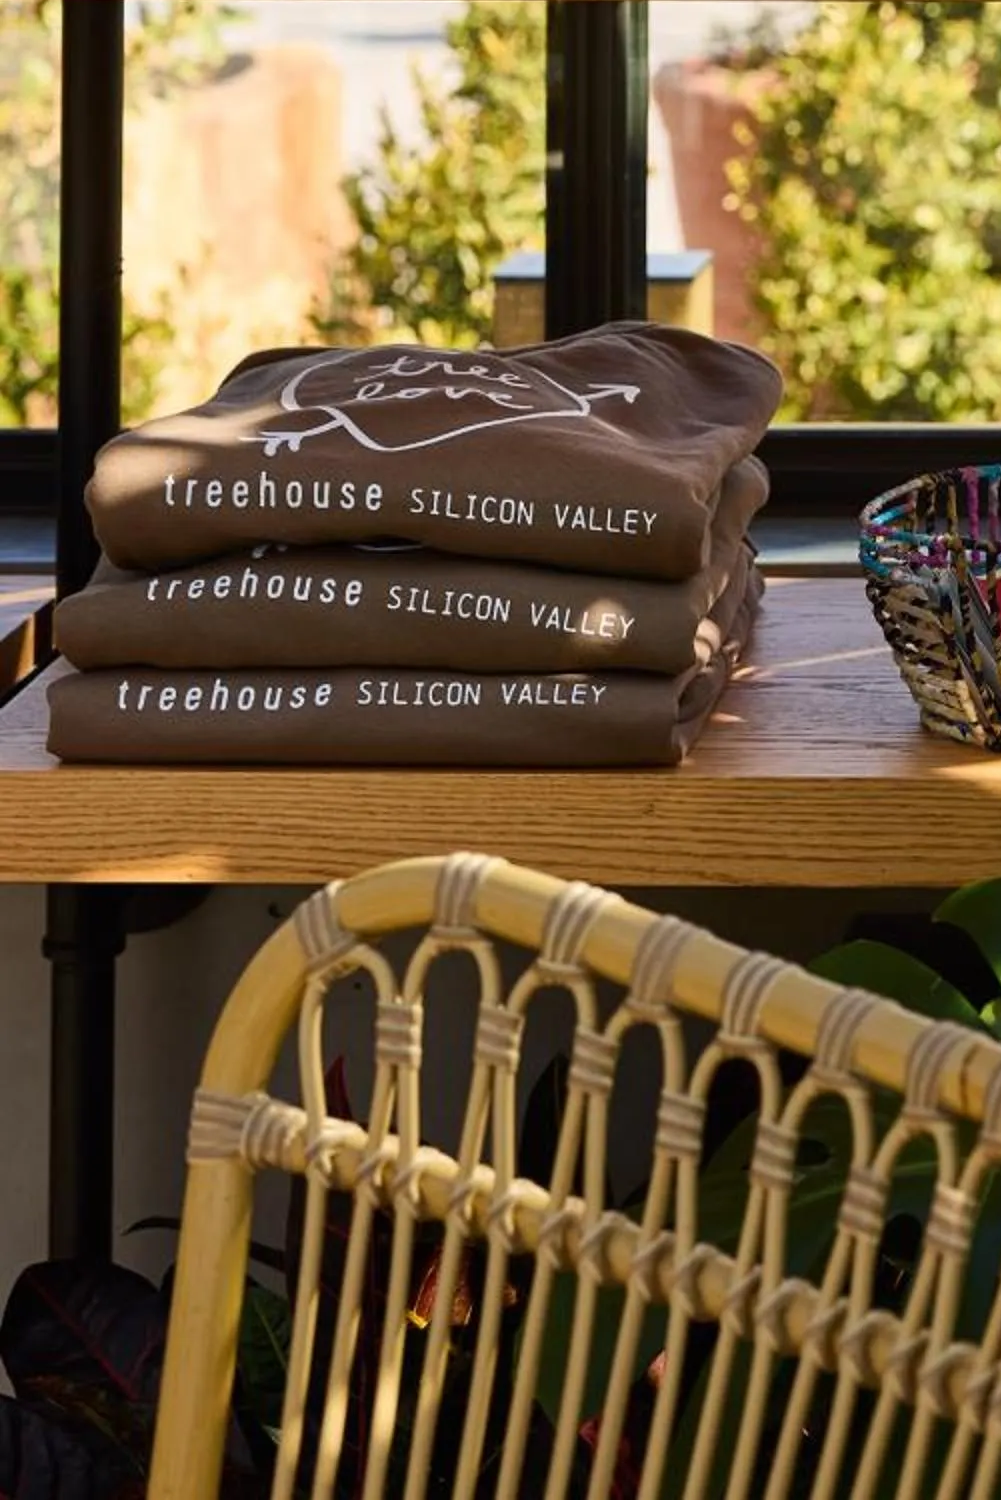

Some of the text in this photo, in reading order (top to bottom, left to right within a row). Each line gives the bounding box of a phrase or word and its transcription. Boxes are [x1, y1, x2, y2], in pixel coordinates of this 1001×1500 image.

[353, 355, 532, 388] tree
[355, 382, 534, 410] love
[164, 471, 658, 535] treehouse SILICON VALLEY
[146, 567, 635, 640] treehouse SILICON VALLEY
[118, 678, 607, 711] treehouse SILICON VALLEY
